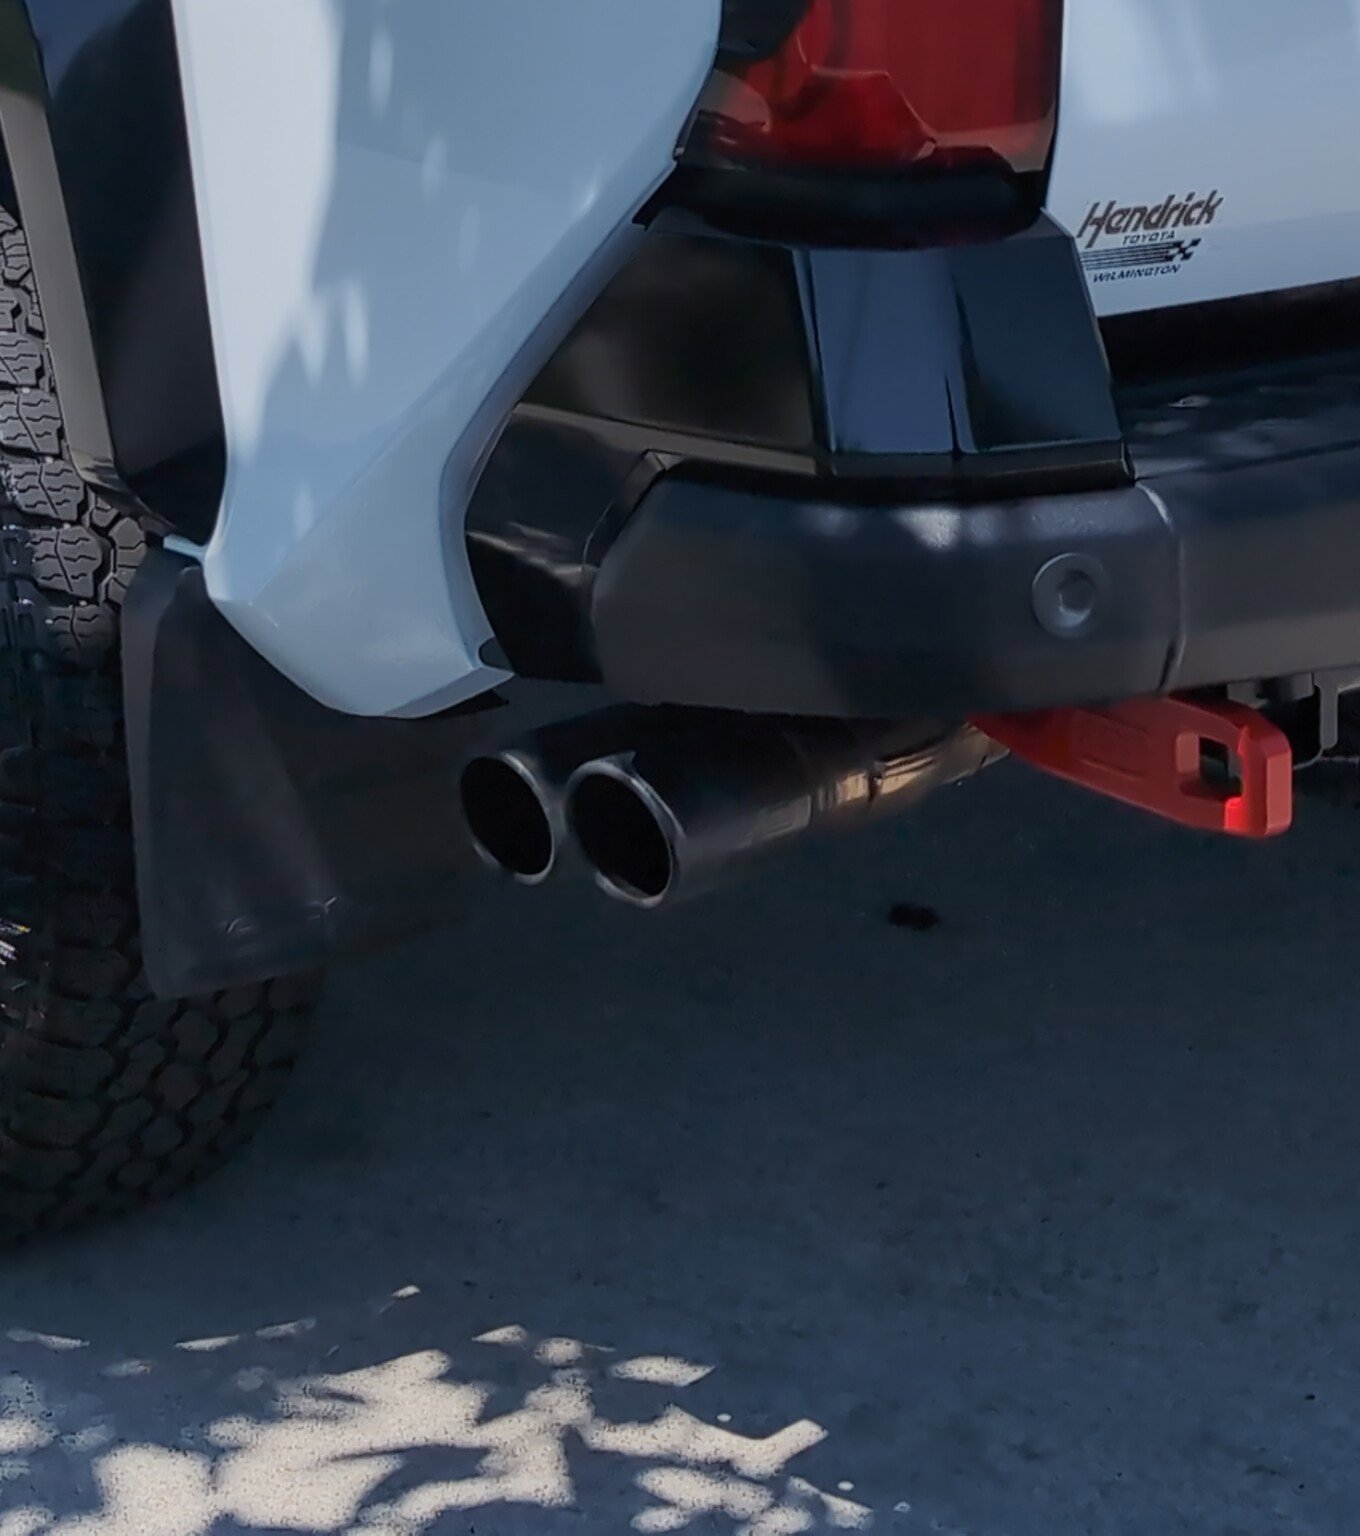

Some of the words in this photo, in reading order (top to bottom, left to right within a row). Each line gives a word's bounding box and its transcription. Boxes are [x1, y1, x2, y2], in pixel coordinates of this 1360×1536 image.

[1076, 189, 1225, 250] Hendrick
[1122, 230, 1176, 246] TOYOTA
[1092, 264, 1182, 284] WILMINGTON
